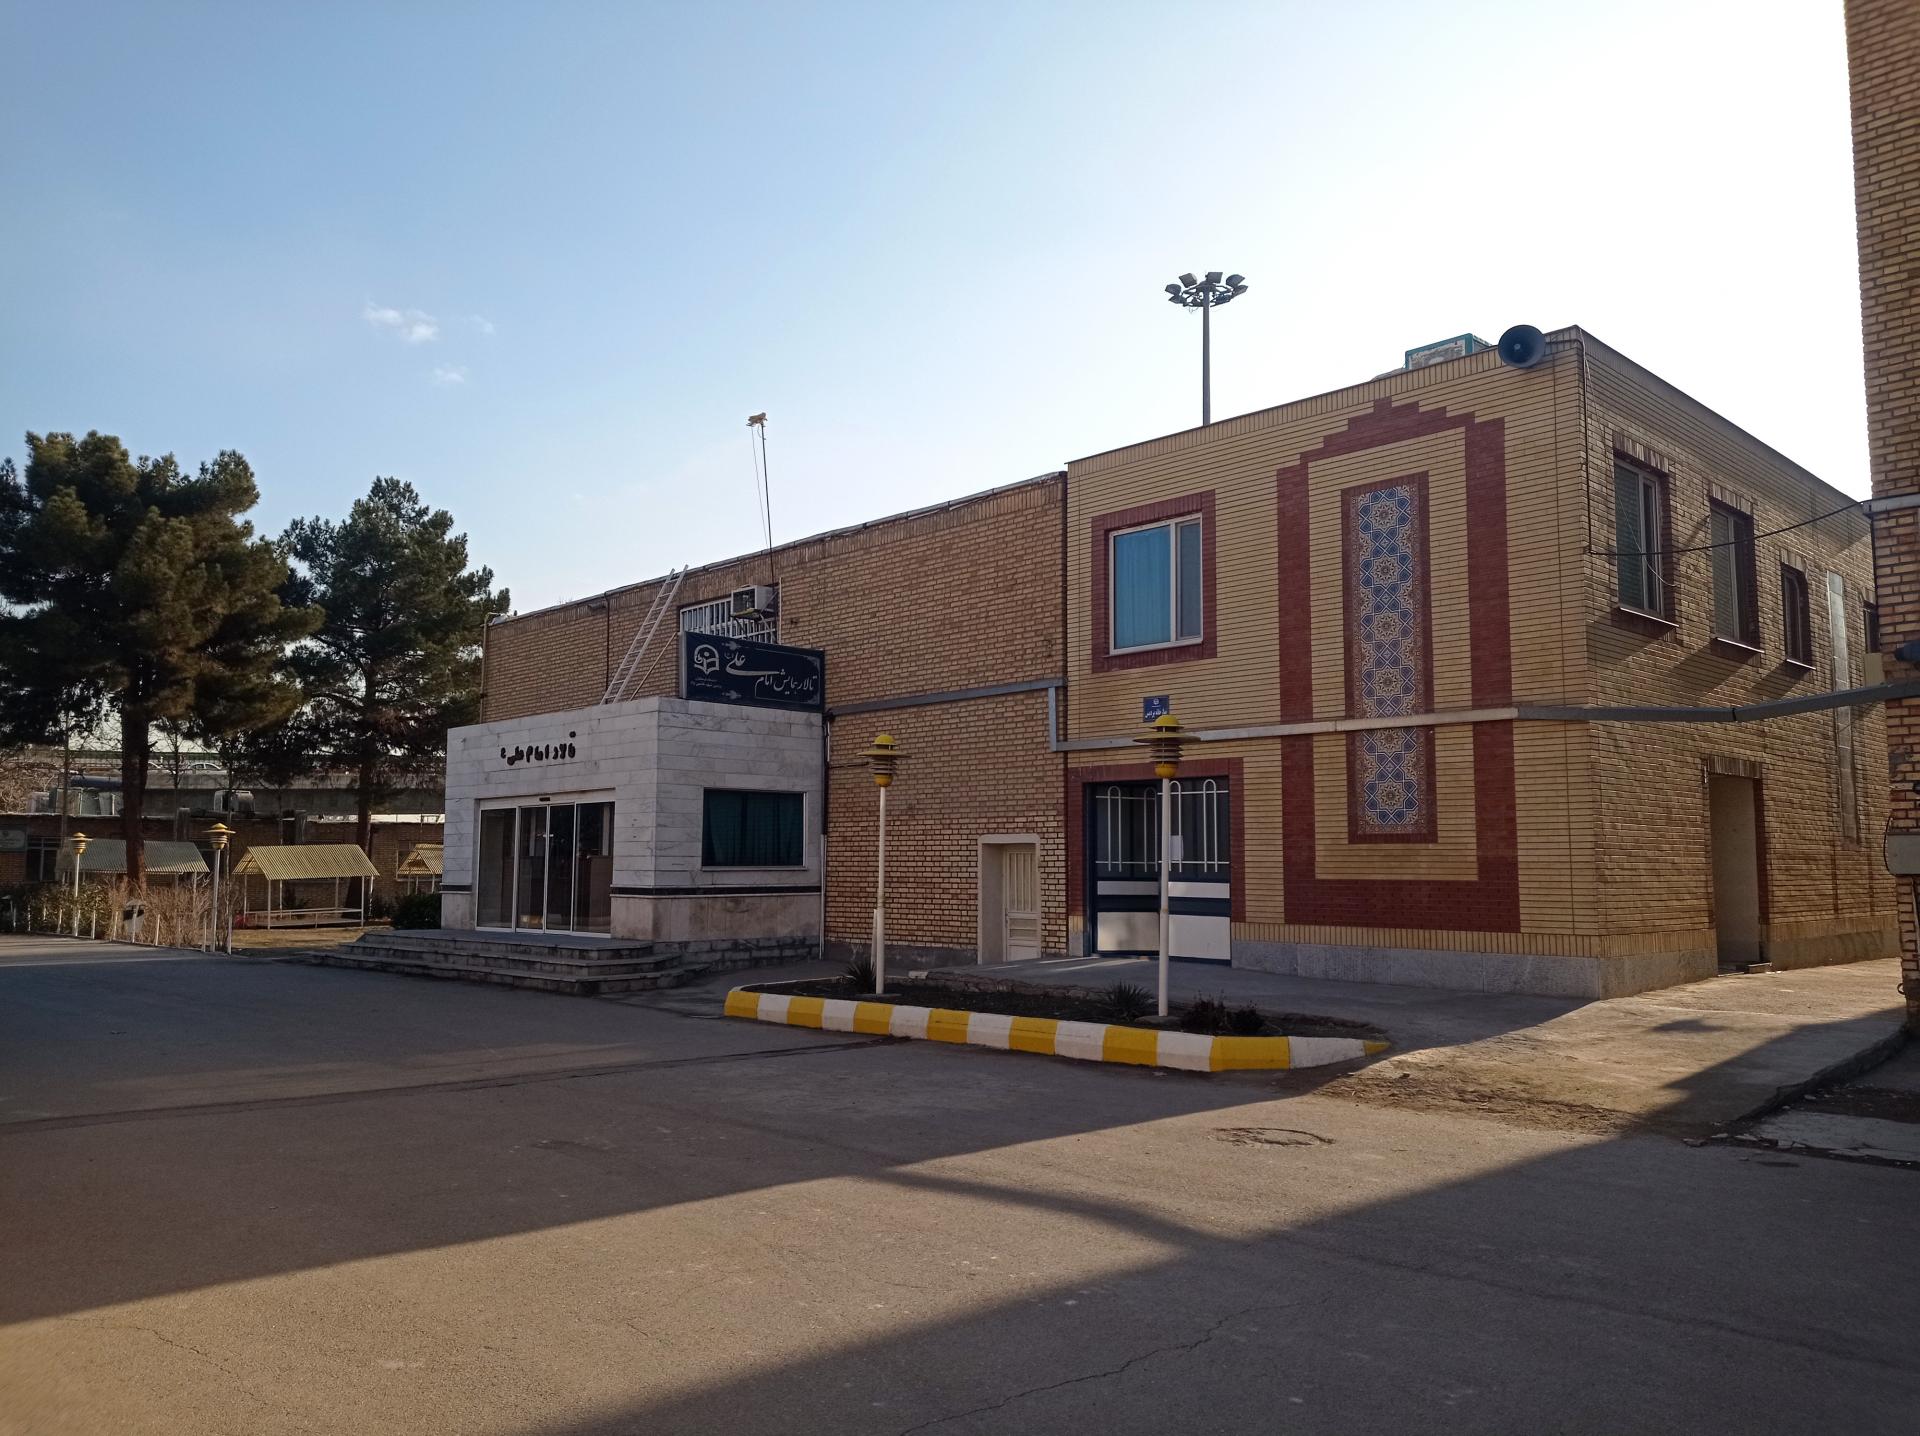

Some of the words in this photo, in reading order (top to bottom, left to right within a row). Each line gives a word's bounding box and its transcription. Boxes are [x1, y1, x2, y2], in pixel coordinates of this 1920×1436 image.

[725, 651, 780, 675] علی
[754, 673, 773, 696] امام
[773, 668, 798, 694] همایش
[796, 675, 818, 691] تالار
[506, 745, 524, 766] علی
[526, 743, 550, 763] امام
[552, 730, 577, 760] تالار
